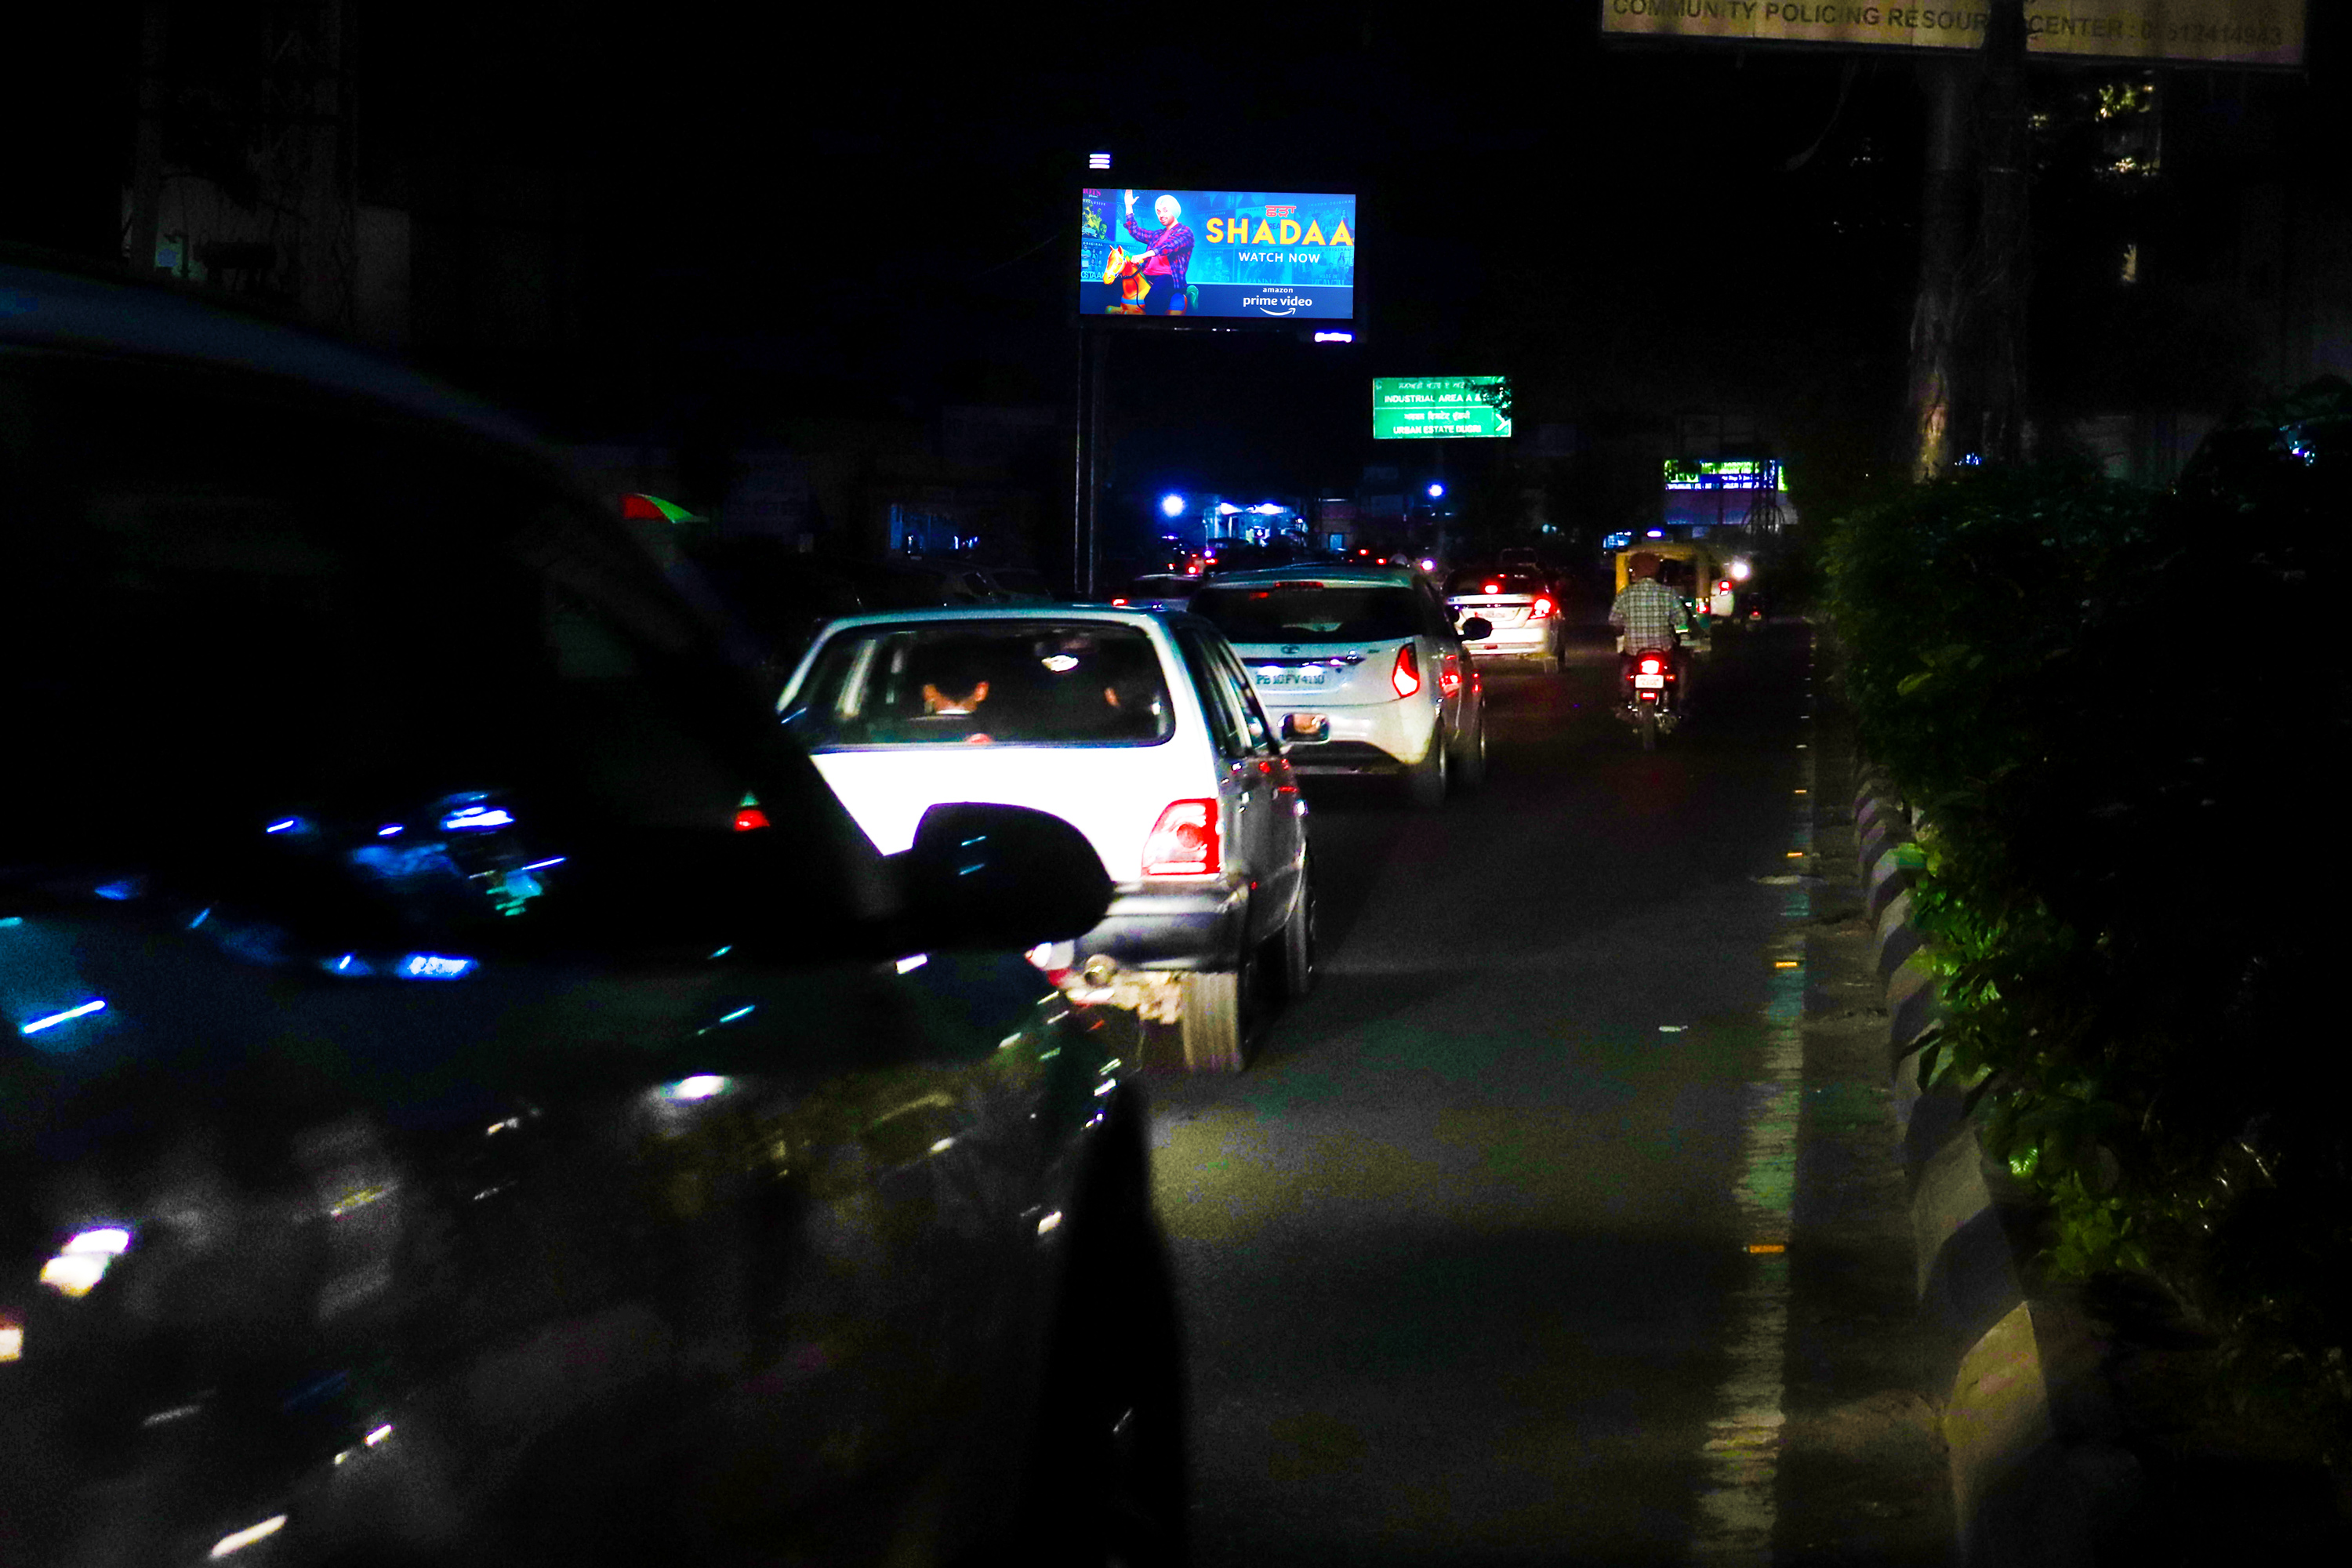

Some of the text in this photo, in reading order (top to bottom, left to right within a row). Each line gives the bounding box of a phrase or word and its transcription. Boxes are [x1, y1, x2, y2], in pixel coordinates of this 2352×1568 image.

[1765, 4, 1879, 25] POLICING
[1888, 8, 1989, 31] RESOUR
[1206, 217, 1354, 246] SHADAA
[1238, 252, 1321, 263] WATCH NOW
[1243, 295, 1313, 307] prime video
[1385, 394, 1435, 403] INDUSTRIAL
[1438, 394, 1464, 402] AREA
[1393, 426, 1421, 434] URBAN
[1423, 426, 1454, 434] ESTATE
